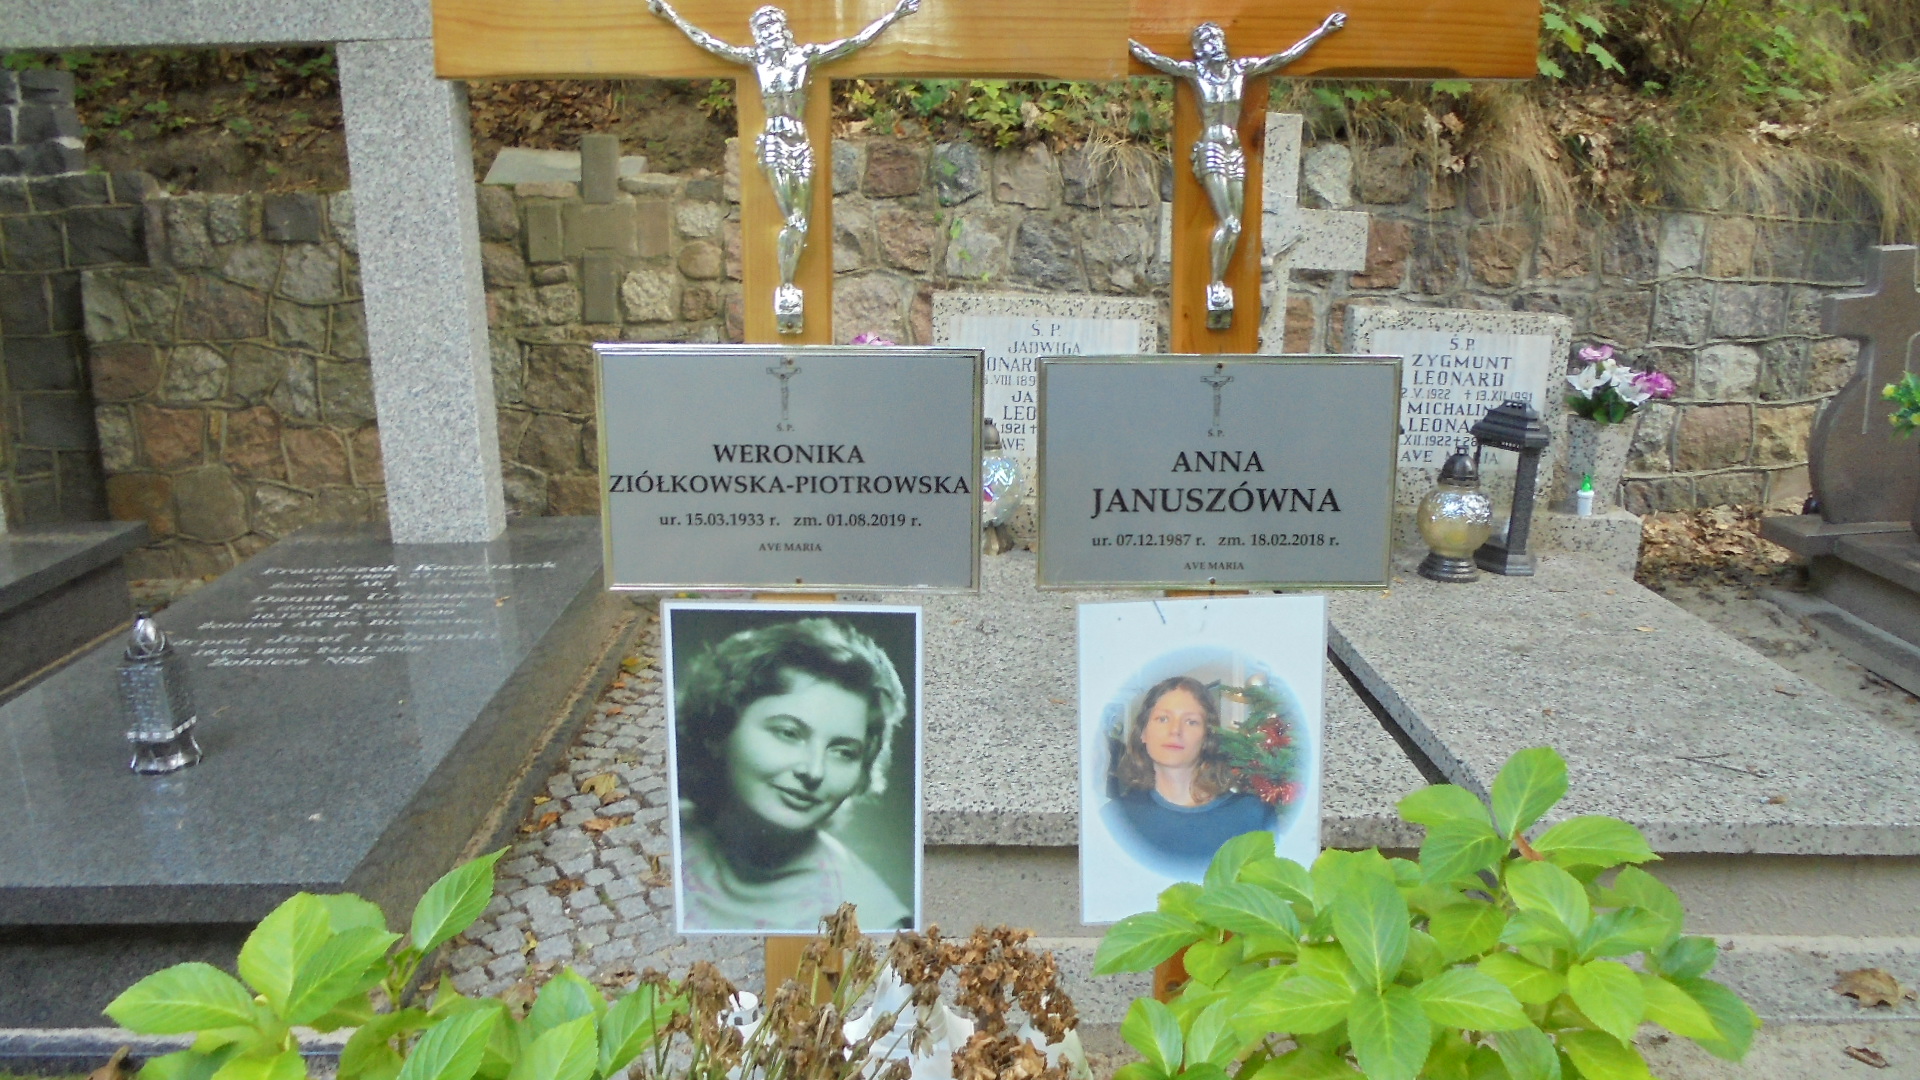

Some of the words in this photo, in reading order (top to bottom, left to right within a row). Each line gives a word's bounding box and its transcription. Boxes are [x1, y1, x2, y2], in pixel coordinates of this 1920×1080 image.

[1008, 341, 1081, 354] JADWIGA
[1412, 354, 1512, 370] ZYGMUNT
[1413, 370, 1504, 387] LEONARD
[1011, 391, 1033, 403] JA
[1003, 406, 1036, 421] LEO
[1407, 402, 1493, 416] MICHALIN
[1408, 418, 1470, 433] LEONA
[1400, 434, 1452, 447] .XII.1922
[714, 444, 866, 463] WERONIKA
[1400, 450, 1432, 463] AVE
[1171, 451, 1265, 473] ANNA
[609, 470, 971, 494] ZIÓŁKOWSKA-PIOTROWSKA
[1091, 482, 1341, 519] JANUSZÓWNA
[659, 516, 681, 527] ur.
[686, 513, 764, 527] 15.03.1933
[769, 516, 780, 527] r.
[793, 516, 822, 527] zm.
[826, 514, 906, 527] 01.08.2019
[911, 516, 922, 527] r.
[759, 543, 782, 552] AVE
[784, 543, 822, 552] MARIA
[1092, 536, 1112, 547] ur.
[1116, 534, 1192, 547] 07.12.1987
[1196, 536, 1206, 547] r.
[1218, 536, 1245, 547] zm.
[1250, 534, 1325, 547] 18.02.2018
[1330, 536, 1340, 547] r.
[1184, 562, 1206, 571] AVE
[1207, 562, 1245, 571] MARIA
